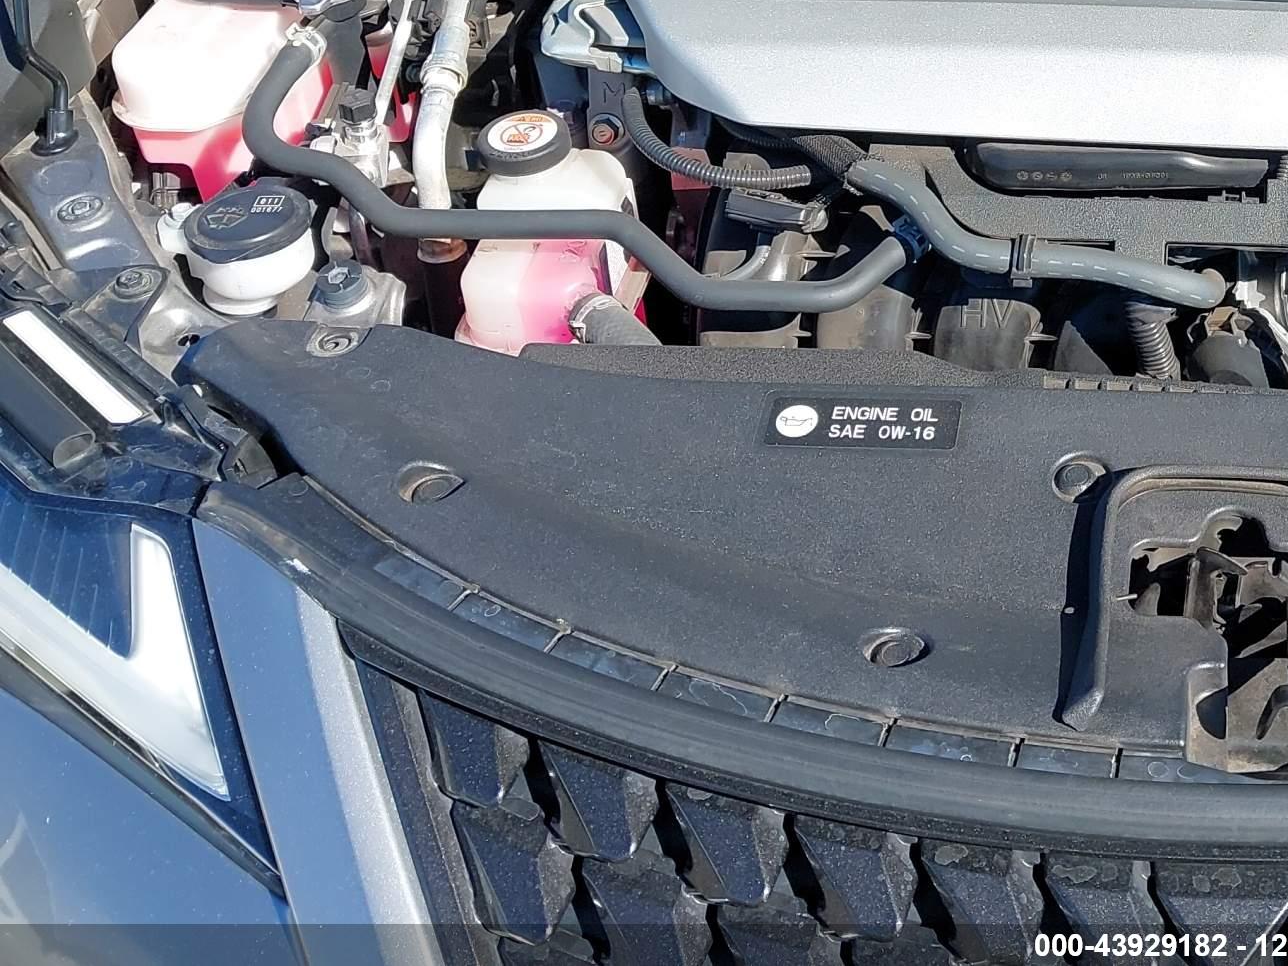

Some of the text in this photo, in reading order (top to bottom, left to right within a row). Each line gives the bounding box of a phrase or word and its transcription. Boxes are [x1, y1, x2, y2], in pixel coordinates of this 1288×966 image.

[960, 298, 1015, 330] HV
[831, 406, 939, 422] ENGINE OIL
[828, 424, 936, 440] SAE 0W-16
